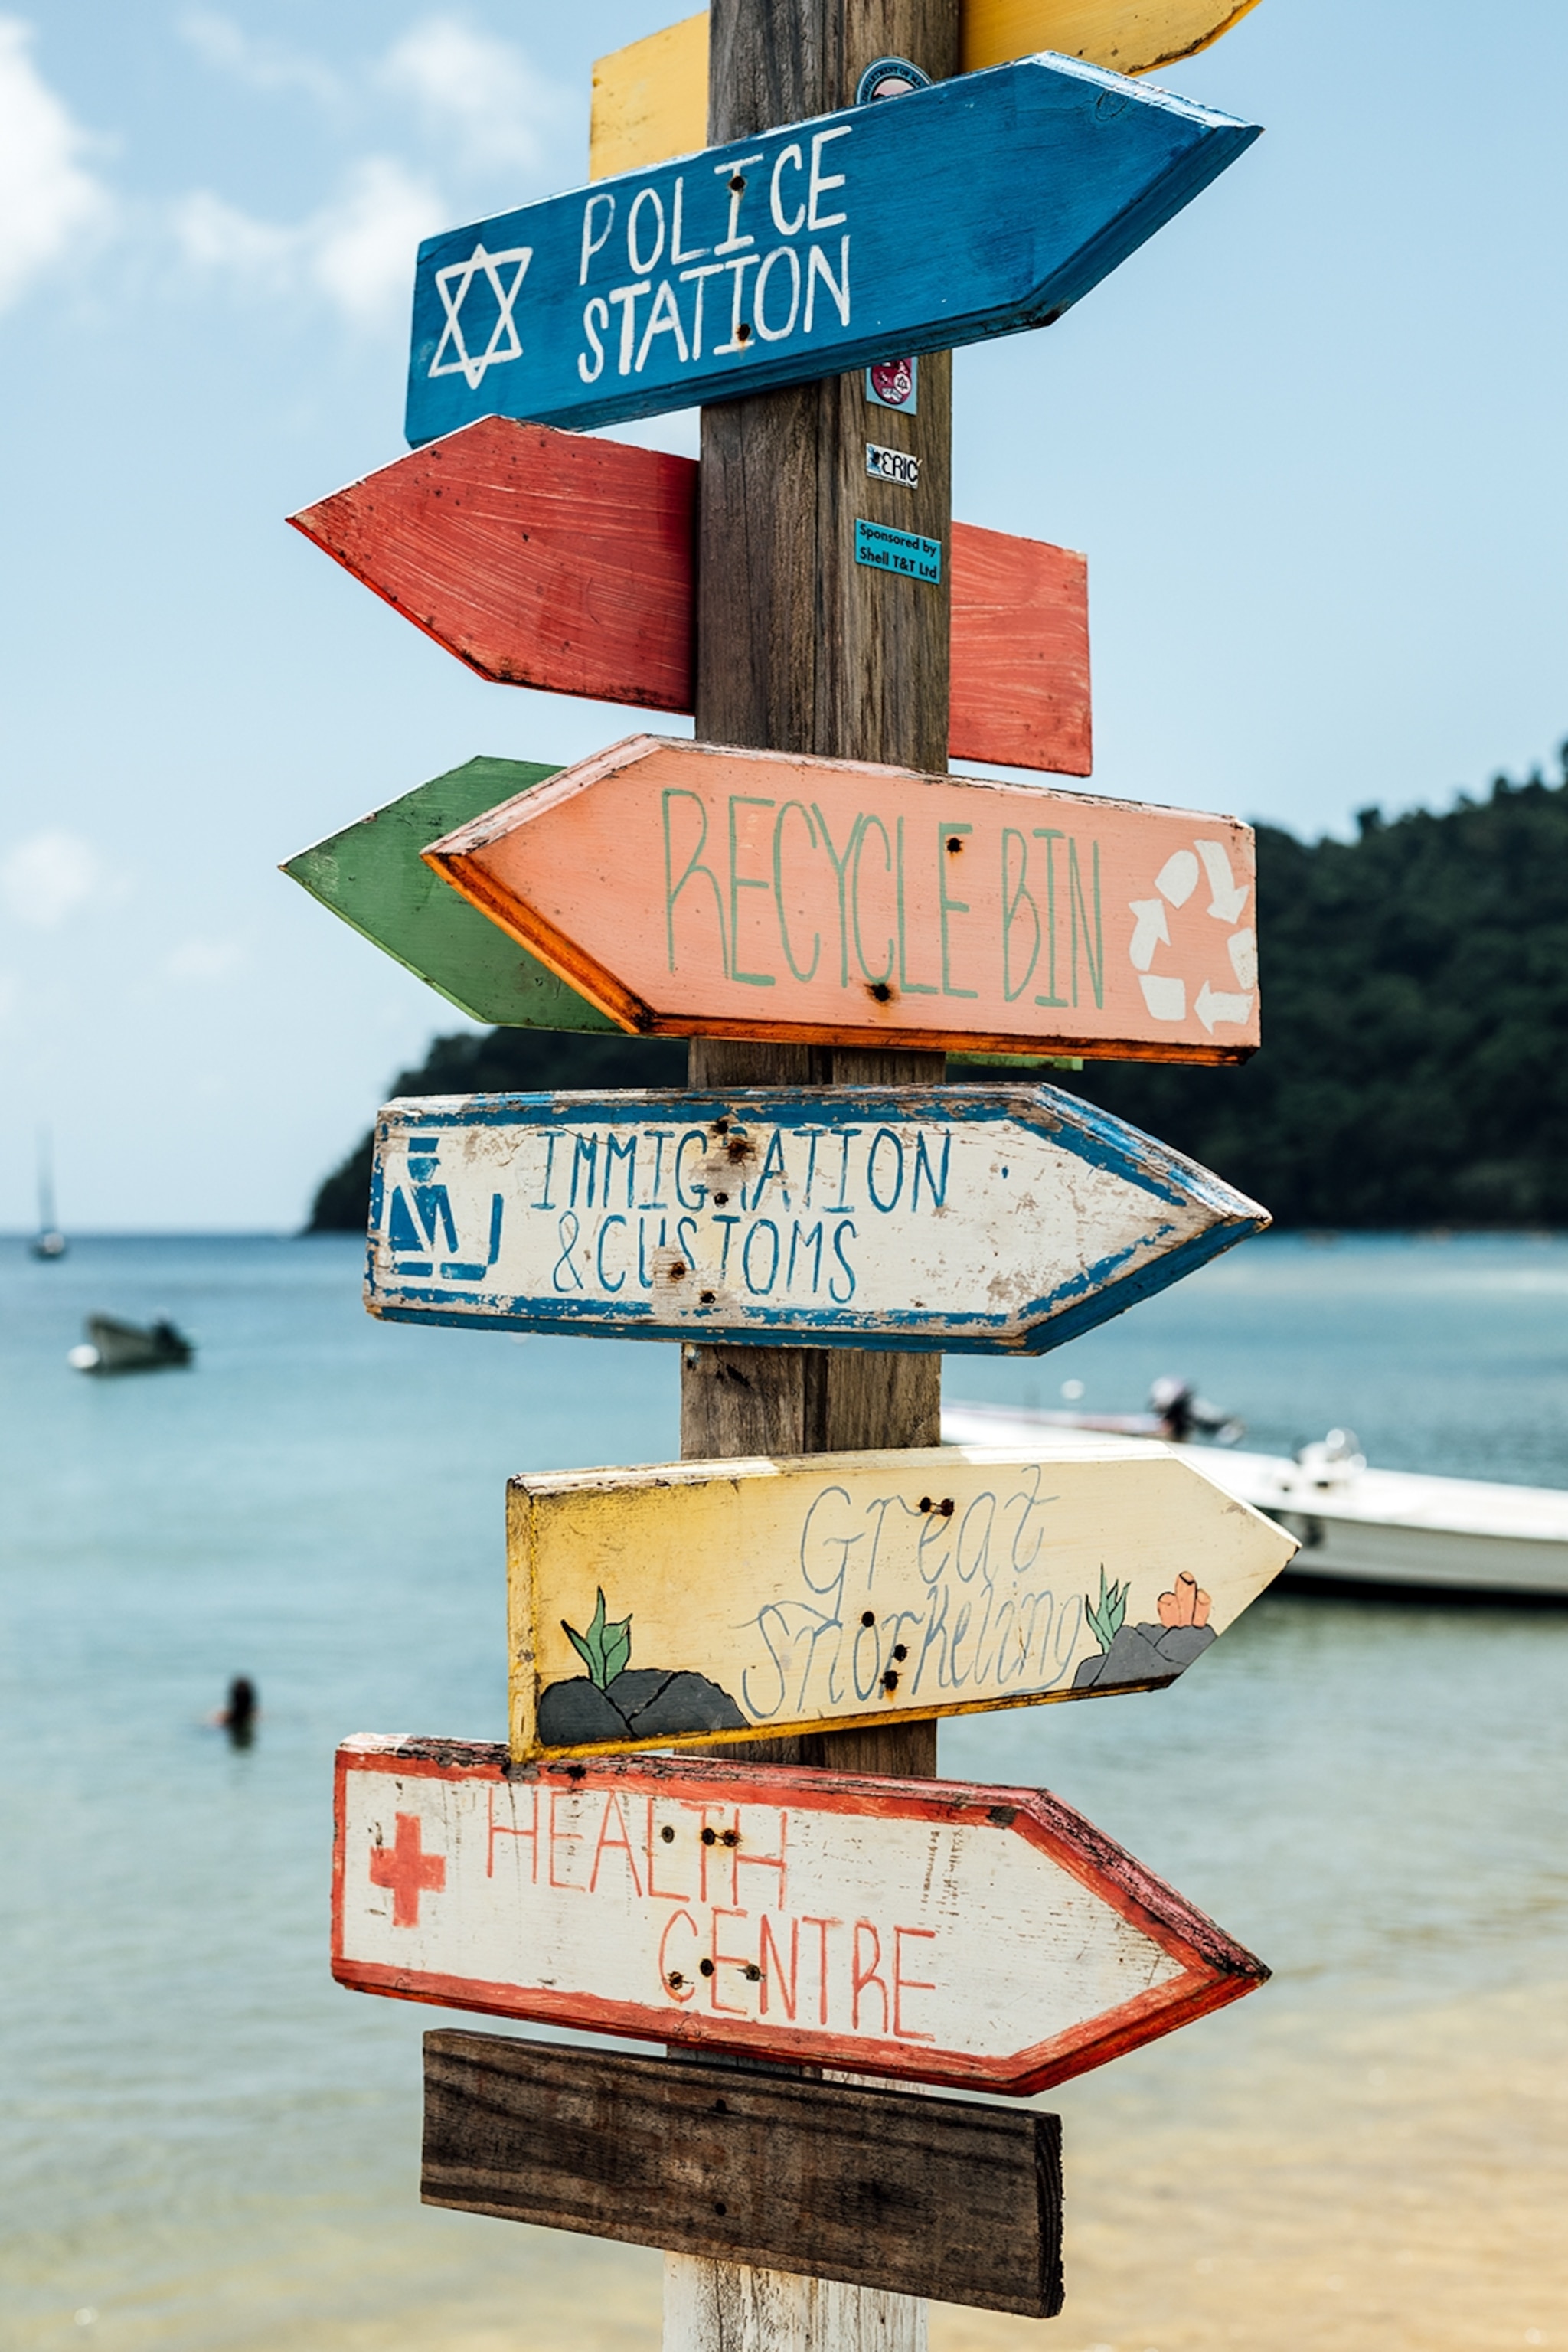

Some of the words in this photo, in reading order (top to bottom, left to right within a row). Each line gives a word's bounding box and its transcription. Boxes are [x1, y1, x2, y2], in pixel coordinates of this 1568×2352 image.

[580, 125, 852, 286] POLICE
[578, 235, 851, 383] STATION
[881, 452, 919, 482] ERIC
[859, 523, 920, 550] Sponsored
[923, 539, 937, 558] by
[859, 547, 889, 567] Shell
[893, 554, 916, 573] T&T
[920, 562, 937, 580] Ltd
[662, 788, 979, 999] RECYCLE
[1001, 827, 1105, 1009] BIN
[800, 1465, 1061, 1625] Great
[485, 1786, 788, 1911] HEALTH
[659, 1906, 936, 2042] CENTRE
